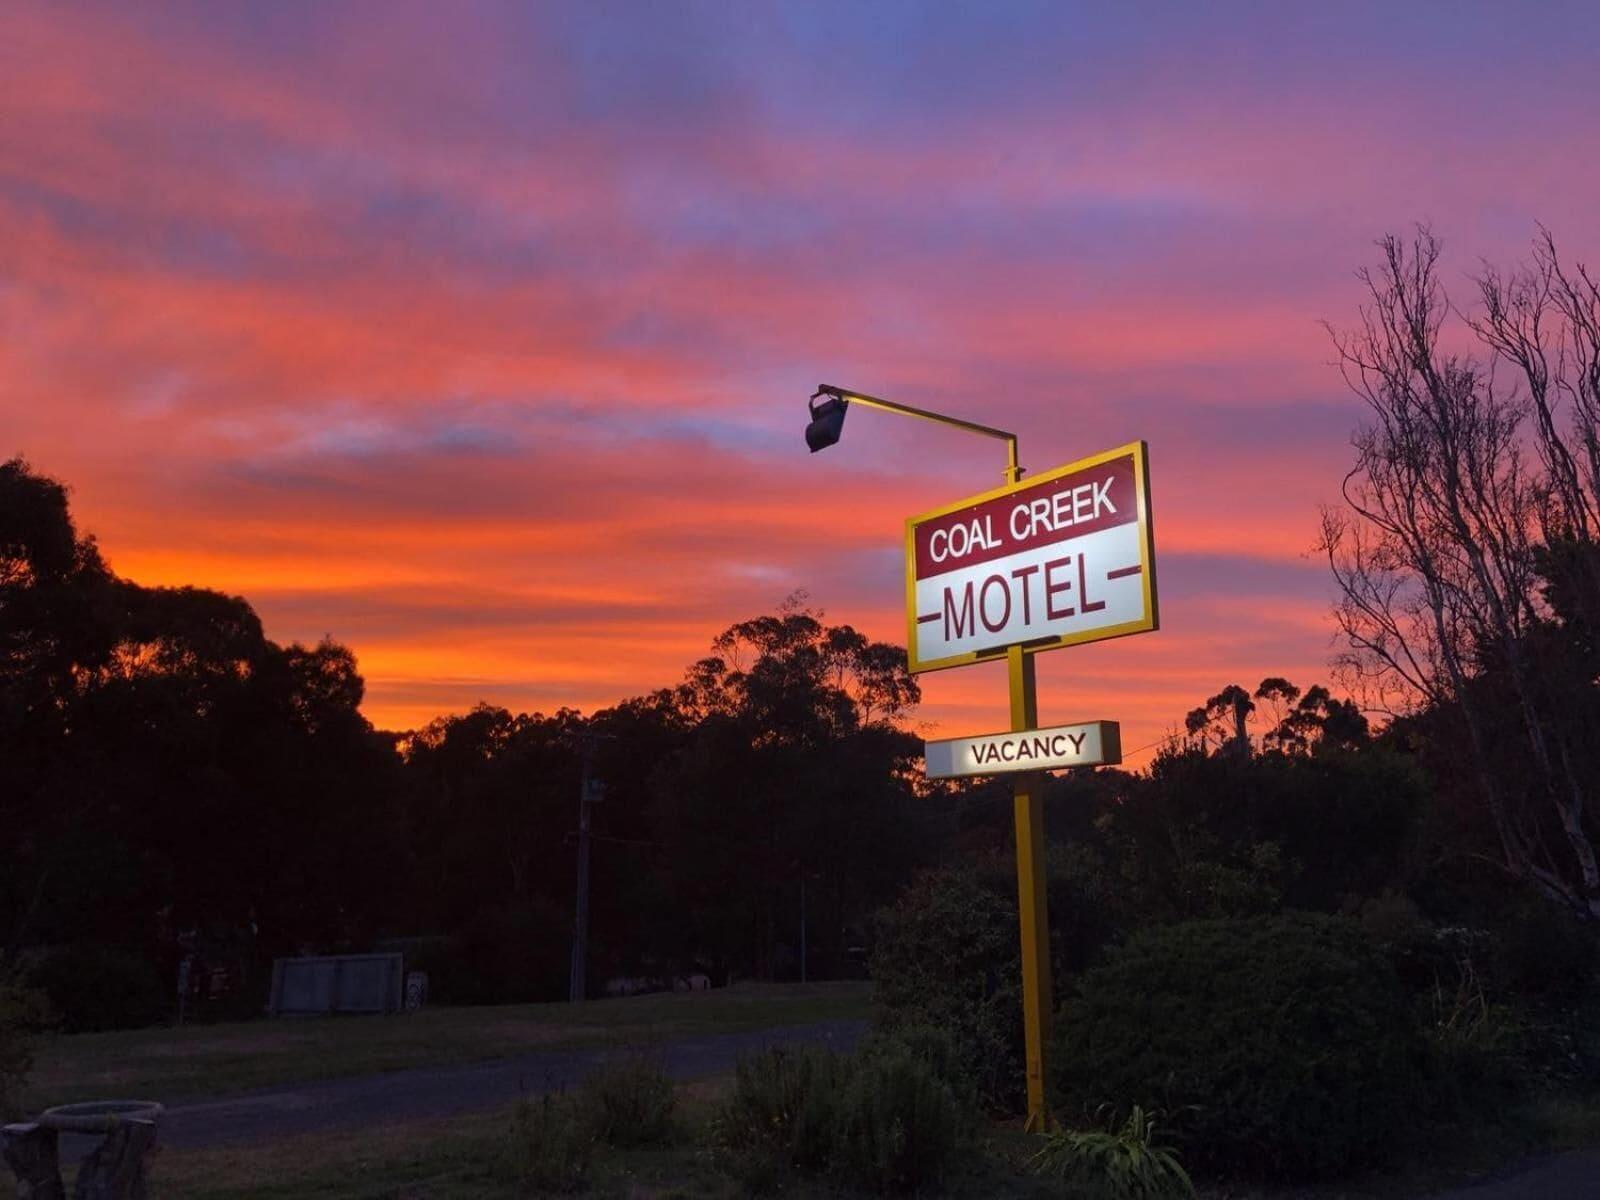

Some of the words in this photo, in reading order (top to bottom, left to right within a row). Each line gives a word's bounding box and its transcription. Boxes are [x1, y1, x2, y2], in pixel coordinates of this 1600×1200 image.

[930, 515, 1002, 563] COAL
[1009, 476, 1117, 541] CREEK
[971, 732, 1087, 764] VACANCY
